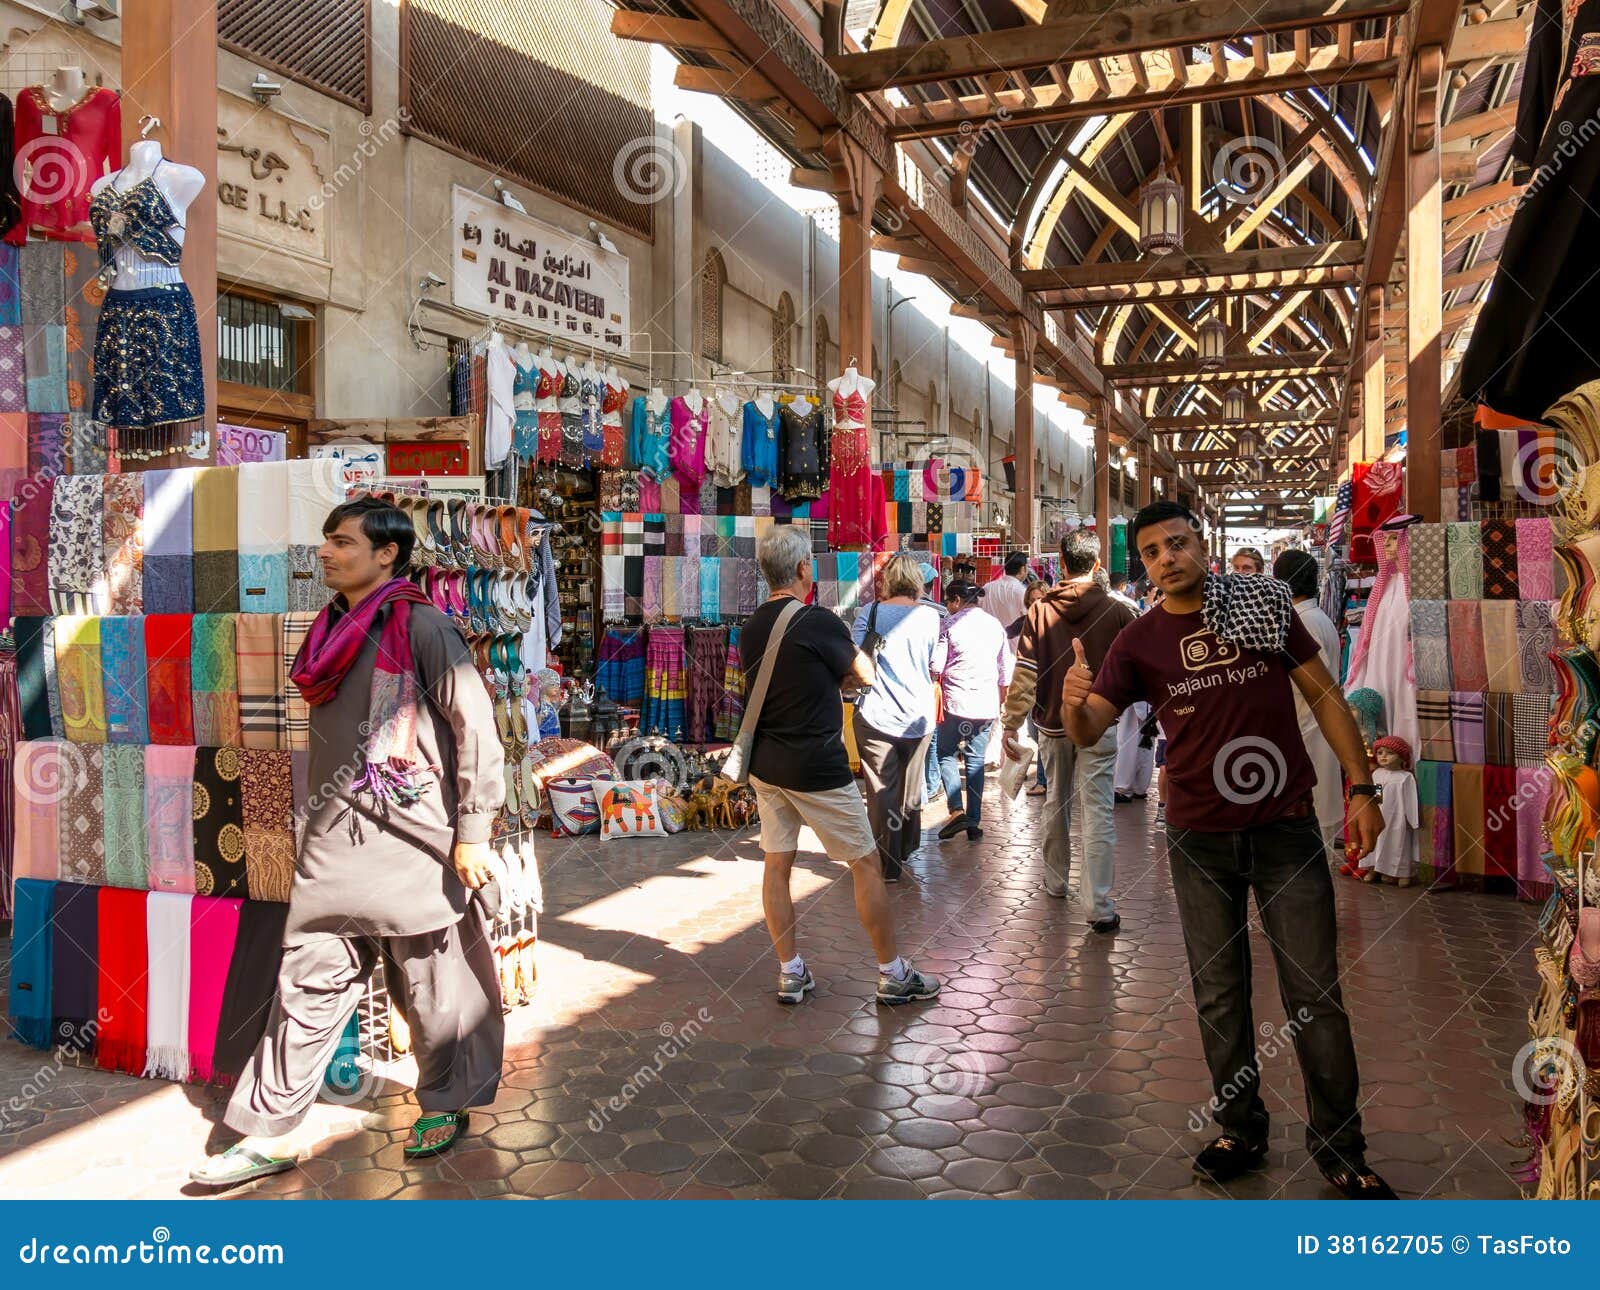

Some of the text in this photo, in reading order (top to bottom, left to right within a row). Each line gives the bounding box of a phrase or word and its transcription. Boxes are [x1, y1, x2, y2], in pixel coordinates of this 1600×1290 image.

[487, 257, 605, 319] AL MAZAYEEN
[230, 429, 272, 455] 500
[1166, 661, 1266, 697] bajaun kya?
